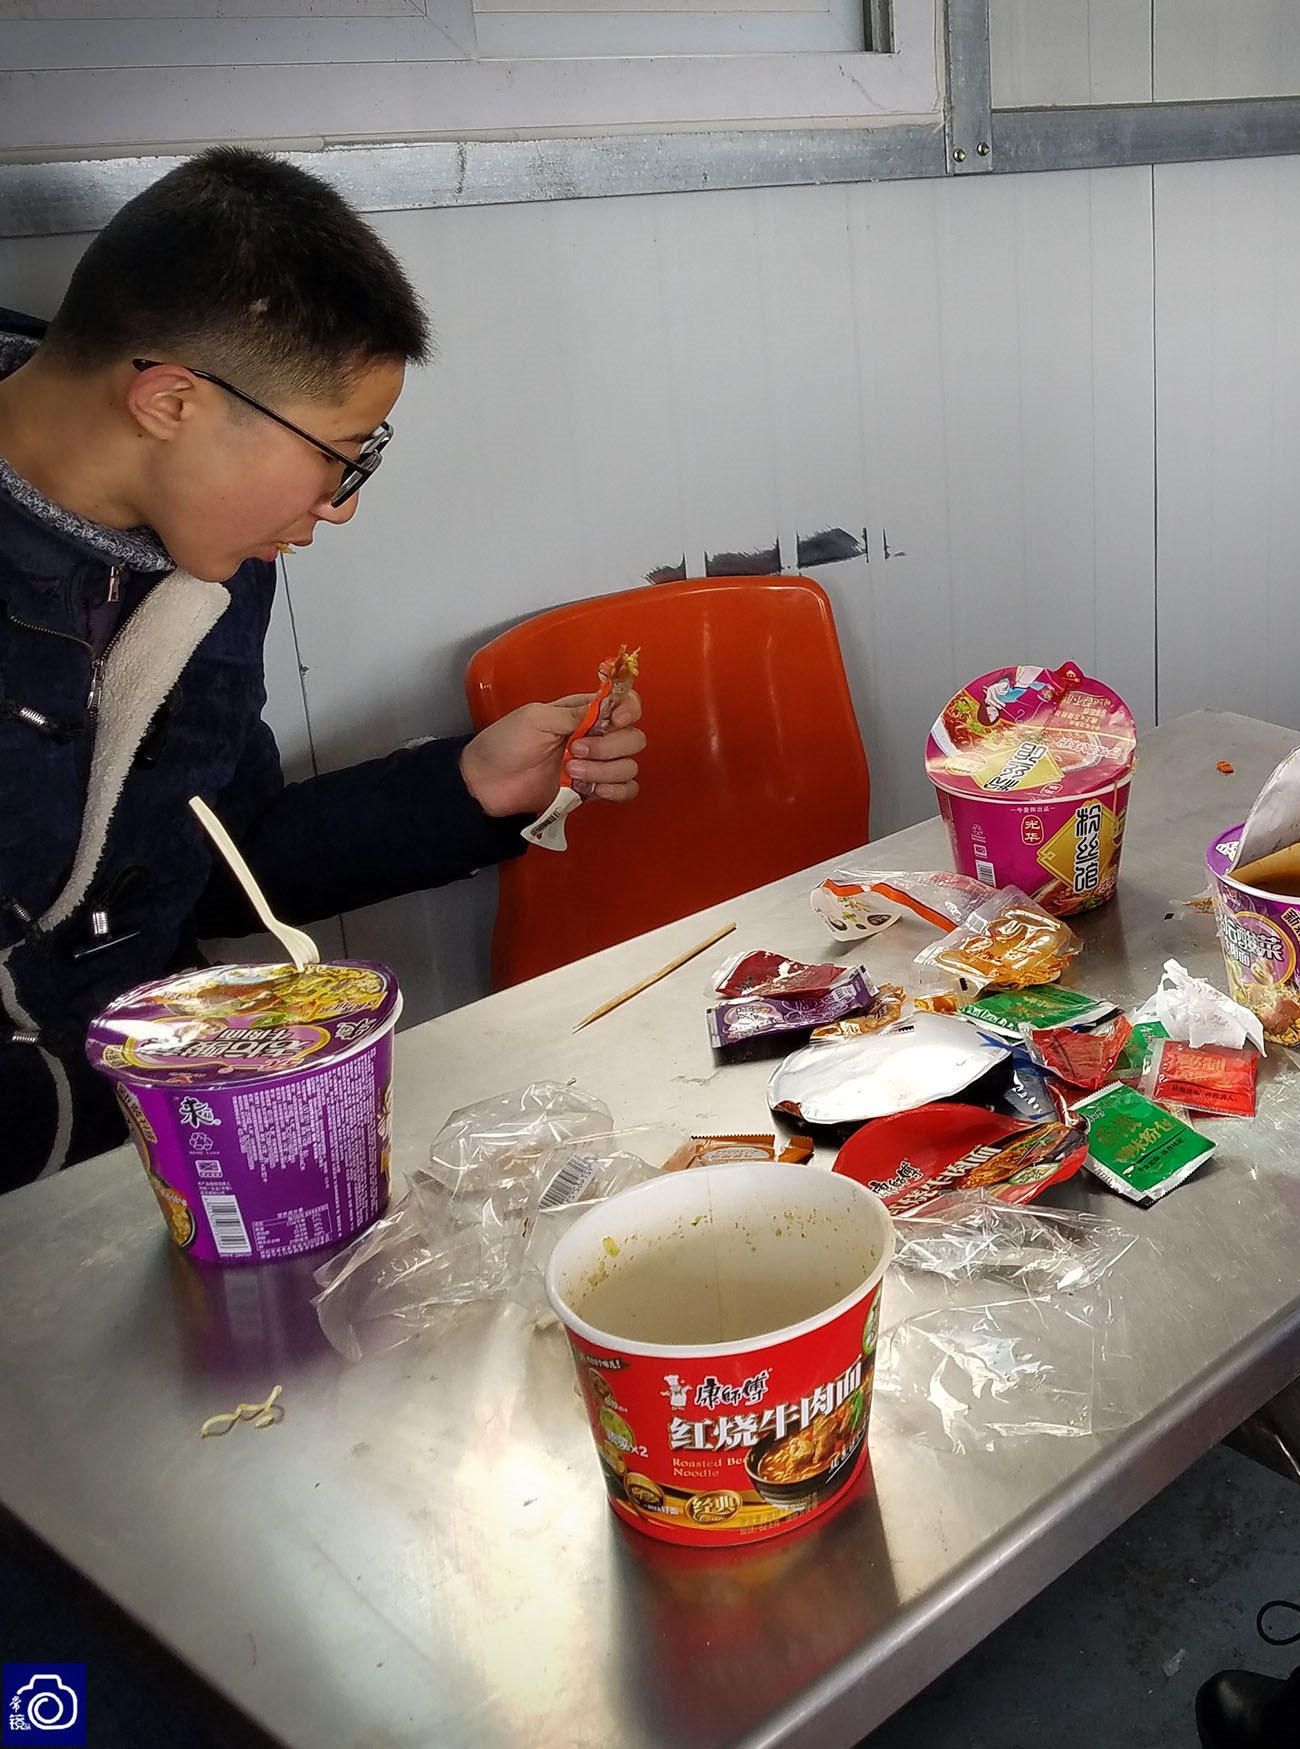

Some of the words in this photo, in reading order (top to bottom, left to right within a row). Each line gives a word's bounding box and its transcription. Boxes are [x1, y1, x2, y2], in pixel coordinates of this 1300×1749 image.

[1024, 819, 1041, 843] 光华
[1074, 804, 1101, 893] 粉丝馆
[669, 1355, 863, 1452] 红烧牛肉面
[673, 1457, 722, 1469] Roasted
[674, 1468, 720, 1478] Noodle
[693, 1495, 737, 1515] 经典
